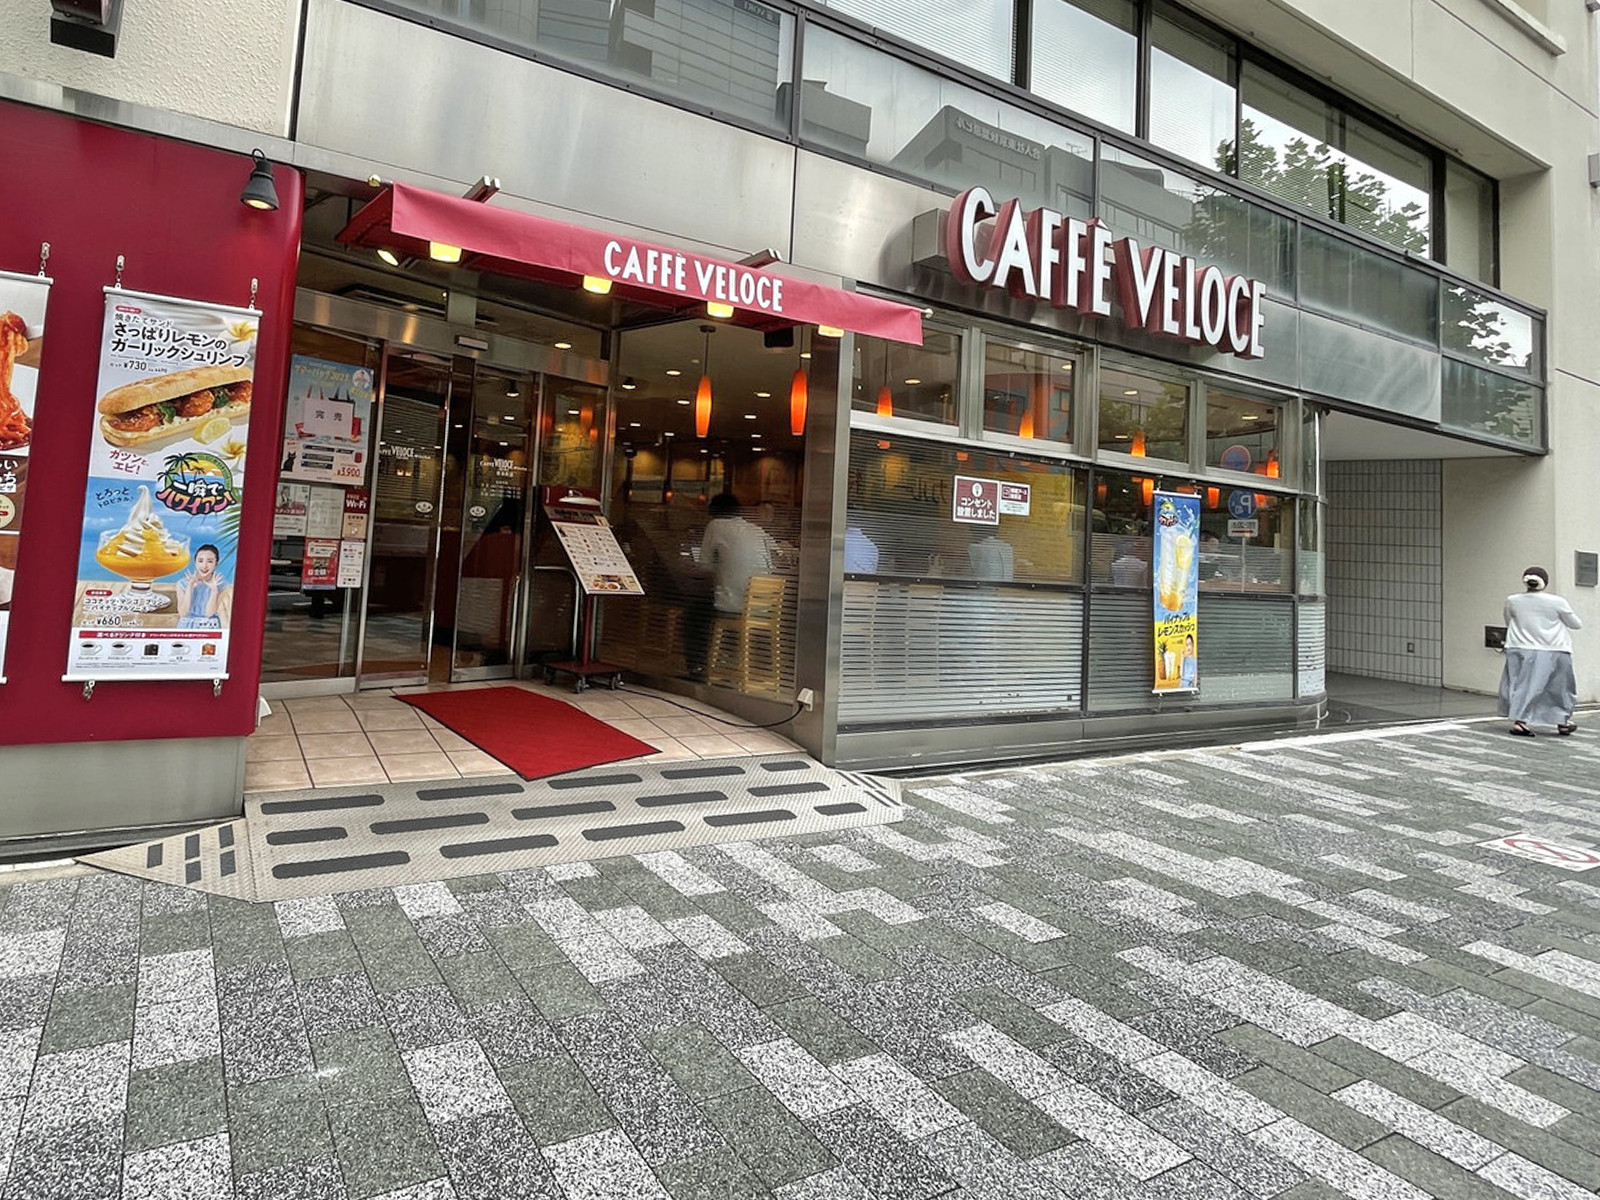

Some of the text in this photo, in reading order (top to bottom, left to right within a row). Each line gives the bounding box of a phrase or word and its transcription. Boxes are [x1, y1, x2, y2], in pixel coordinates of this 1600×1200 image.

[693, 259, 785, 313] VELOCE
[1127, 237, 1268, 359] VELOCE
[113, 312, 173, 328] 焼きたてサンド
[113, 321, 227, 350] さっぱりレモンの
[111, 337, 249, 368] ガーリックシュリンプ
[0, 459, 18, 470] い
[0, 471, 17, 484] ち
[95, 486, 130, 501] とろっと
[173, 479, 223, 497] 一瞬で
[960, 497, 993, 509] コンセント
[956, 505, 996, 520] 設置しました
